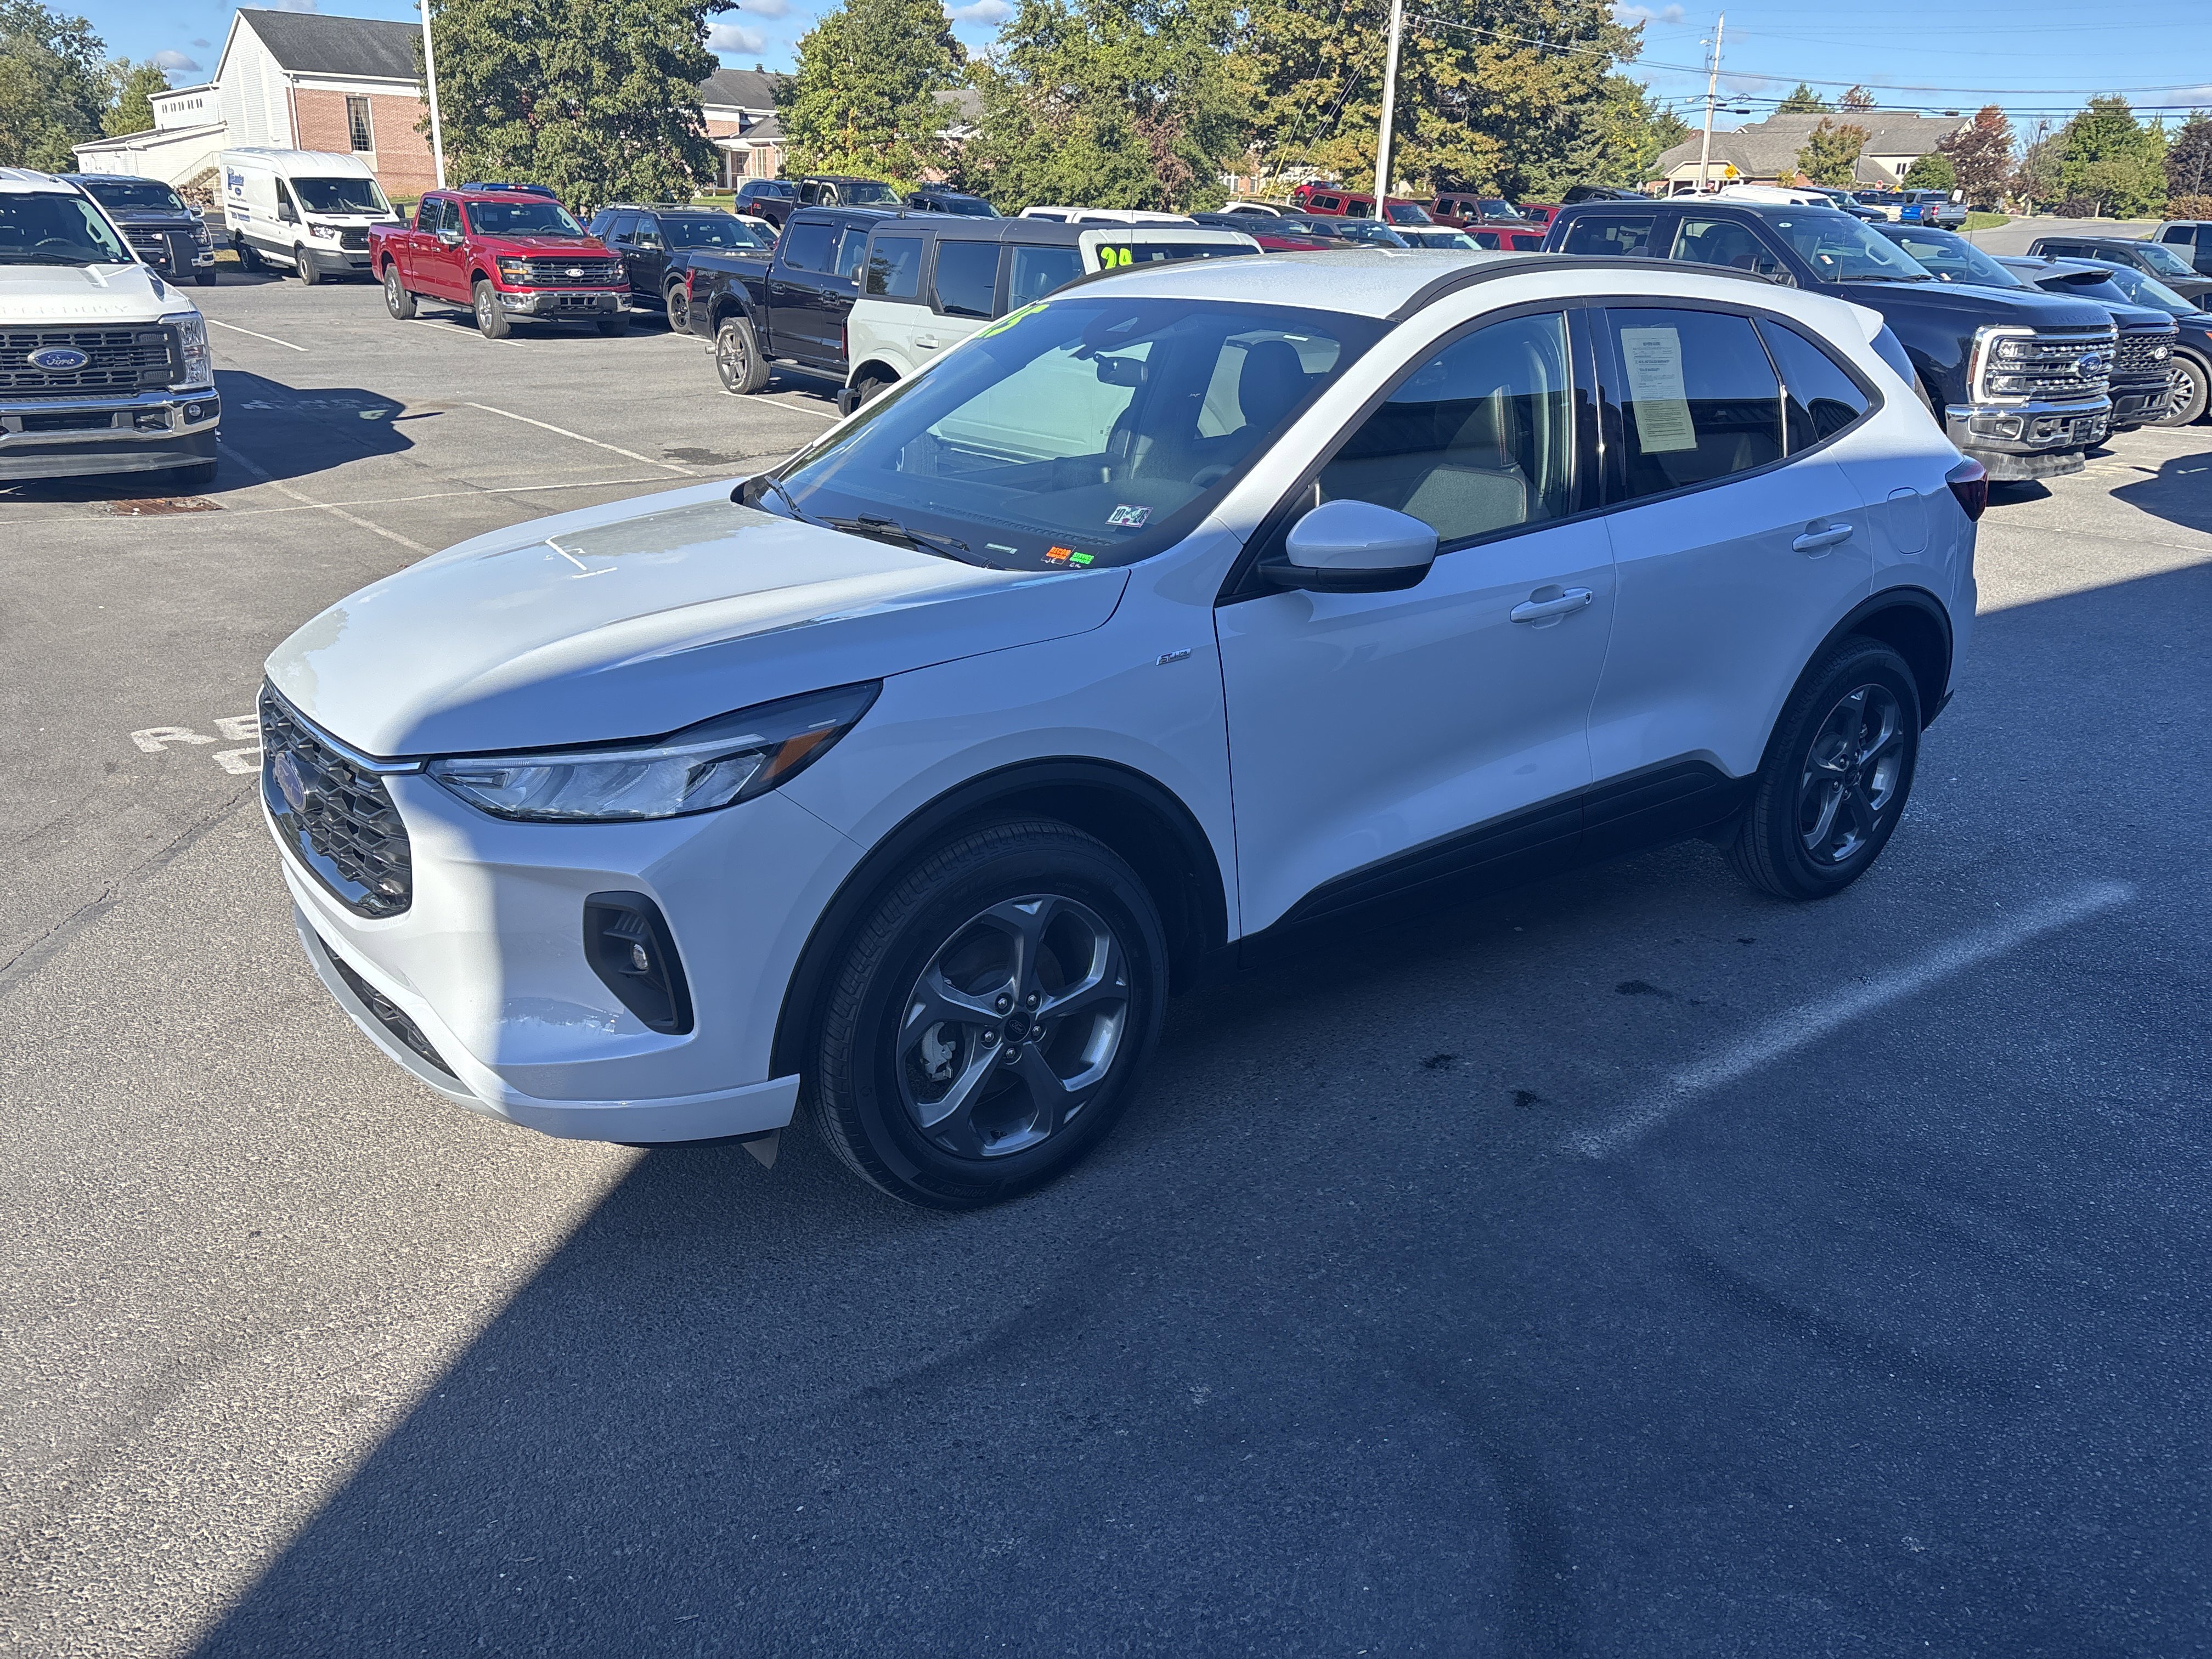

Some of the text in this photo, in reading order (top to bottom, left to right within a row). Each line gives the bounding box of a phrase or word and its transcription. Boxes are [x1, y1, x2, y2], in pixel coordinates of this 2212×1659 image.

[1111, 509, 1126, 522] 10
[1072, 552, 1094, 561] SERVICE
[1160, 653, 1173, 663] ST
